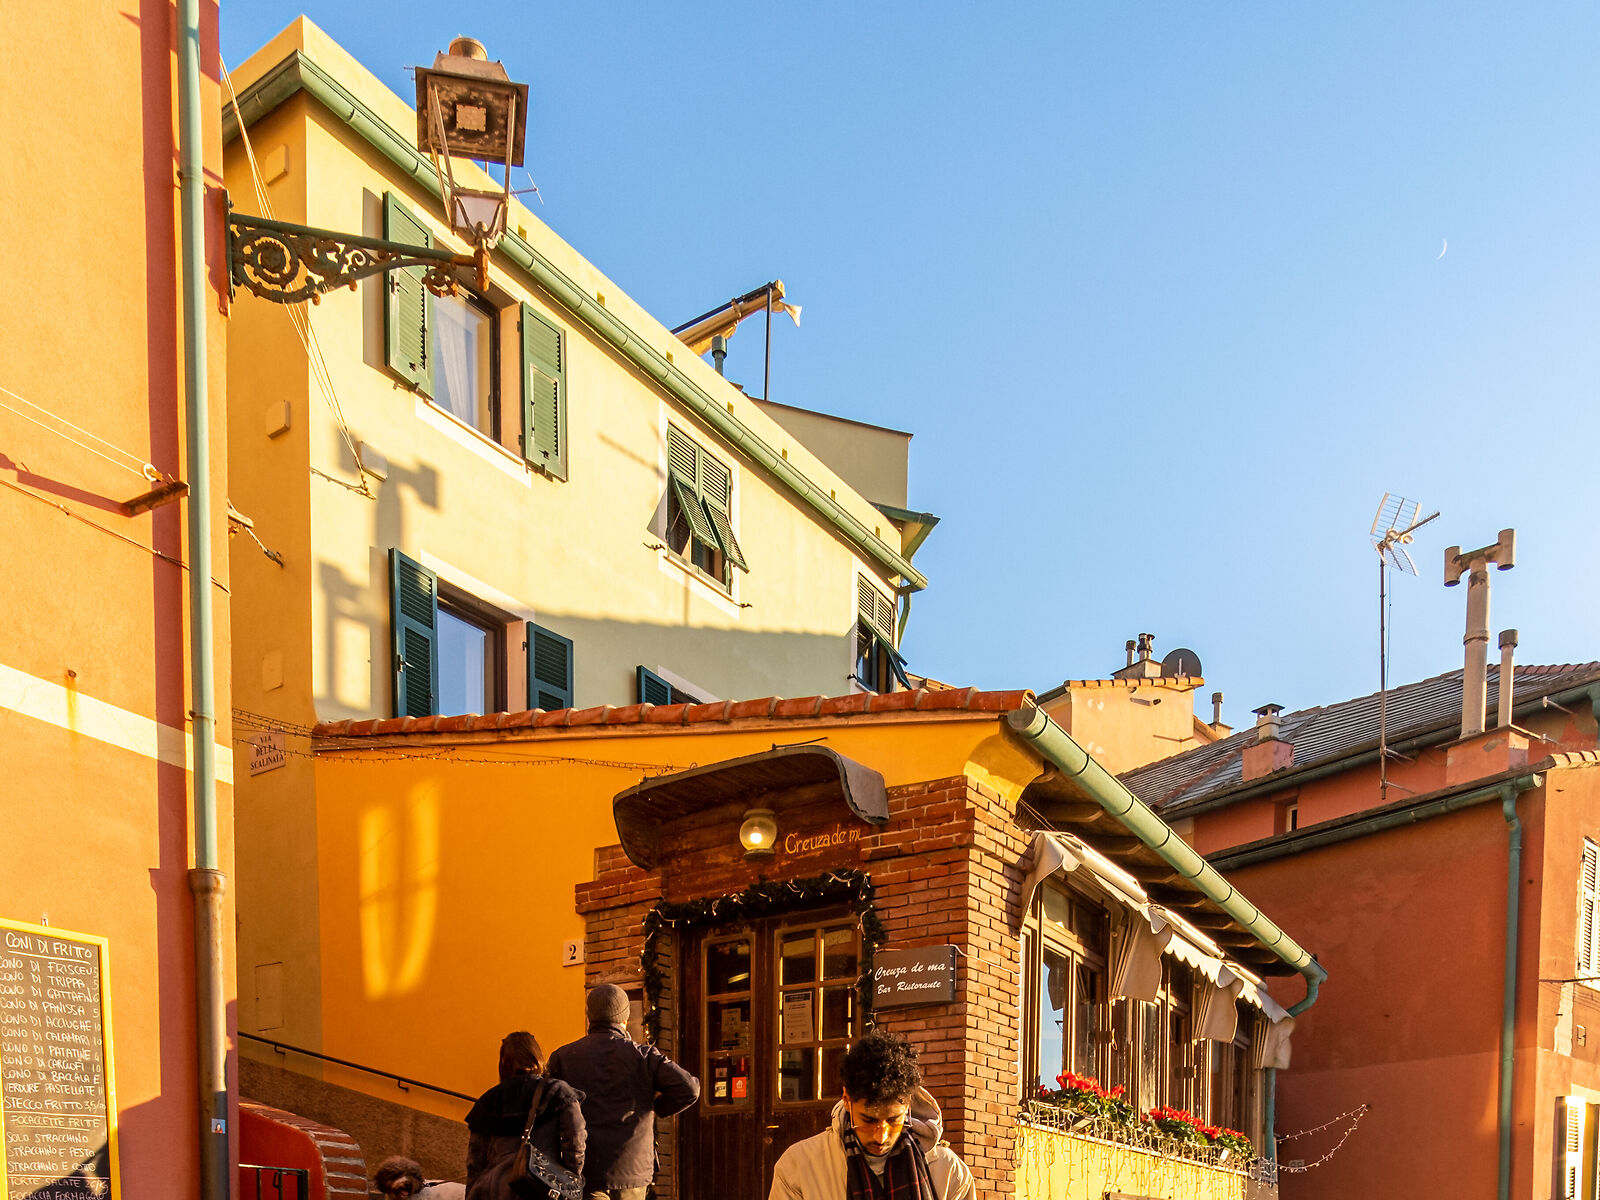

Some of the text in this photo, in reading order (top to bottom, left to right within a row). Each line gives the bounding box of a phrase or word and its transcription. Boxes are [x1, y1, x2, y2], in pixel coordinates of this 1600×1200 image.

[250, 754, 284, 770] SCALINATA
[785, 832, 830, 854] Creuza
[831, 823, 847, 845] de
[6, 932, 92, 958] CONI DI FRITTO
[568, 944, 577, 961] 2
[0, 956, 23, 969] CONO
[30, 960, 40, 972] DI
[48, 961, 92, 975] FRISCEU
[874, 961, 947, 981] Creuza de ma
[0, 971, 24, 982] CONO
[30, 973, 41, 984] DI
[47, 975, 85, 989] TRIPPA
[877, 980, 942, 994] Bar Ristorante
[0, 984, 24, 995] CONO
[31, 985, 42, 998] DI
[0, 997, 26, 1009] CONO
[29, 1000, 38, 1010] DI
[42, 1001, 85, 1016] PANISSA
[1, 1011, 28, 1024] CONO
[30, 1015, 42, 1027] DI
[45, 1015, 91, 1031] ACCIUGHE
[1, 1026, 28, 1037] CONO
[32, 1029, 43, 1041] DI
[45, 1031, 91, 1046] CALAMARI
[2, 1041, 28, 1053] CONO
[33, 1044, 44, 1055] DI
[48, 1045, 91, 1060] PATATINE
[3, 1054, 33, 1066] CONO
[35, 1057, 46, 1067] DI
[92, 1063, 101, 1073] 10
[4, 1068, 31, 1079] CONO
[37, 1070, 47, 1080] DI
[51, 1070, 90, 1082] BACCALA
[4, 1082, 40, 1093] VERDURE
[45, 1082, 95, 1096] PASTELLATE
[4, 1095, 42, 1110] STECCO
[44, 1099, 83, 1110] FRITTO
[10, 1115, 100, 1128] FOCACCETTE FRITTE
[6, 1132, 88, 1143] SOLO STRACCHINO
[8, 1146, 95, 1158] STRACCHINO E PESTO
[8, 1160, 58, 1173] STRACCHINO
[62, 1162, 68, 1171] E
[8, 1176, 40, 1186] TORTE
[45, 1177, 80, 1187] SALATE
